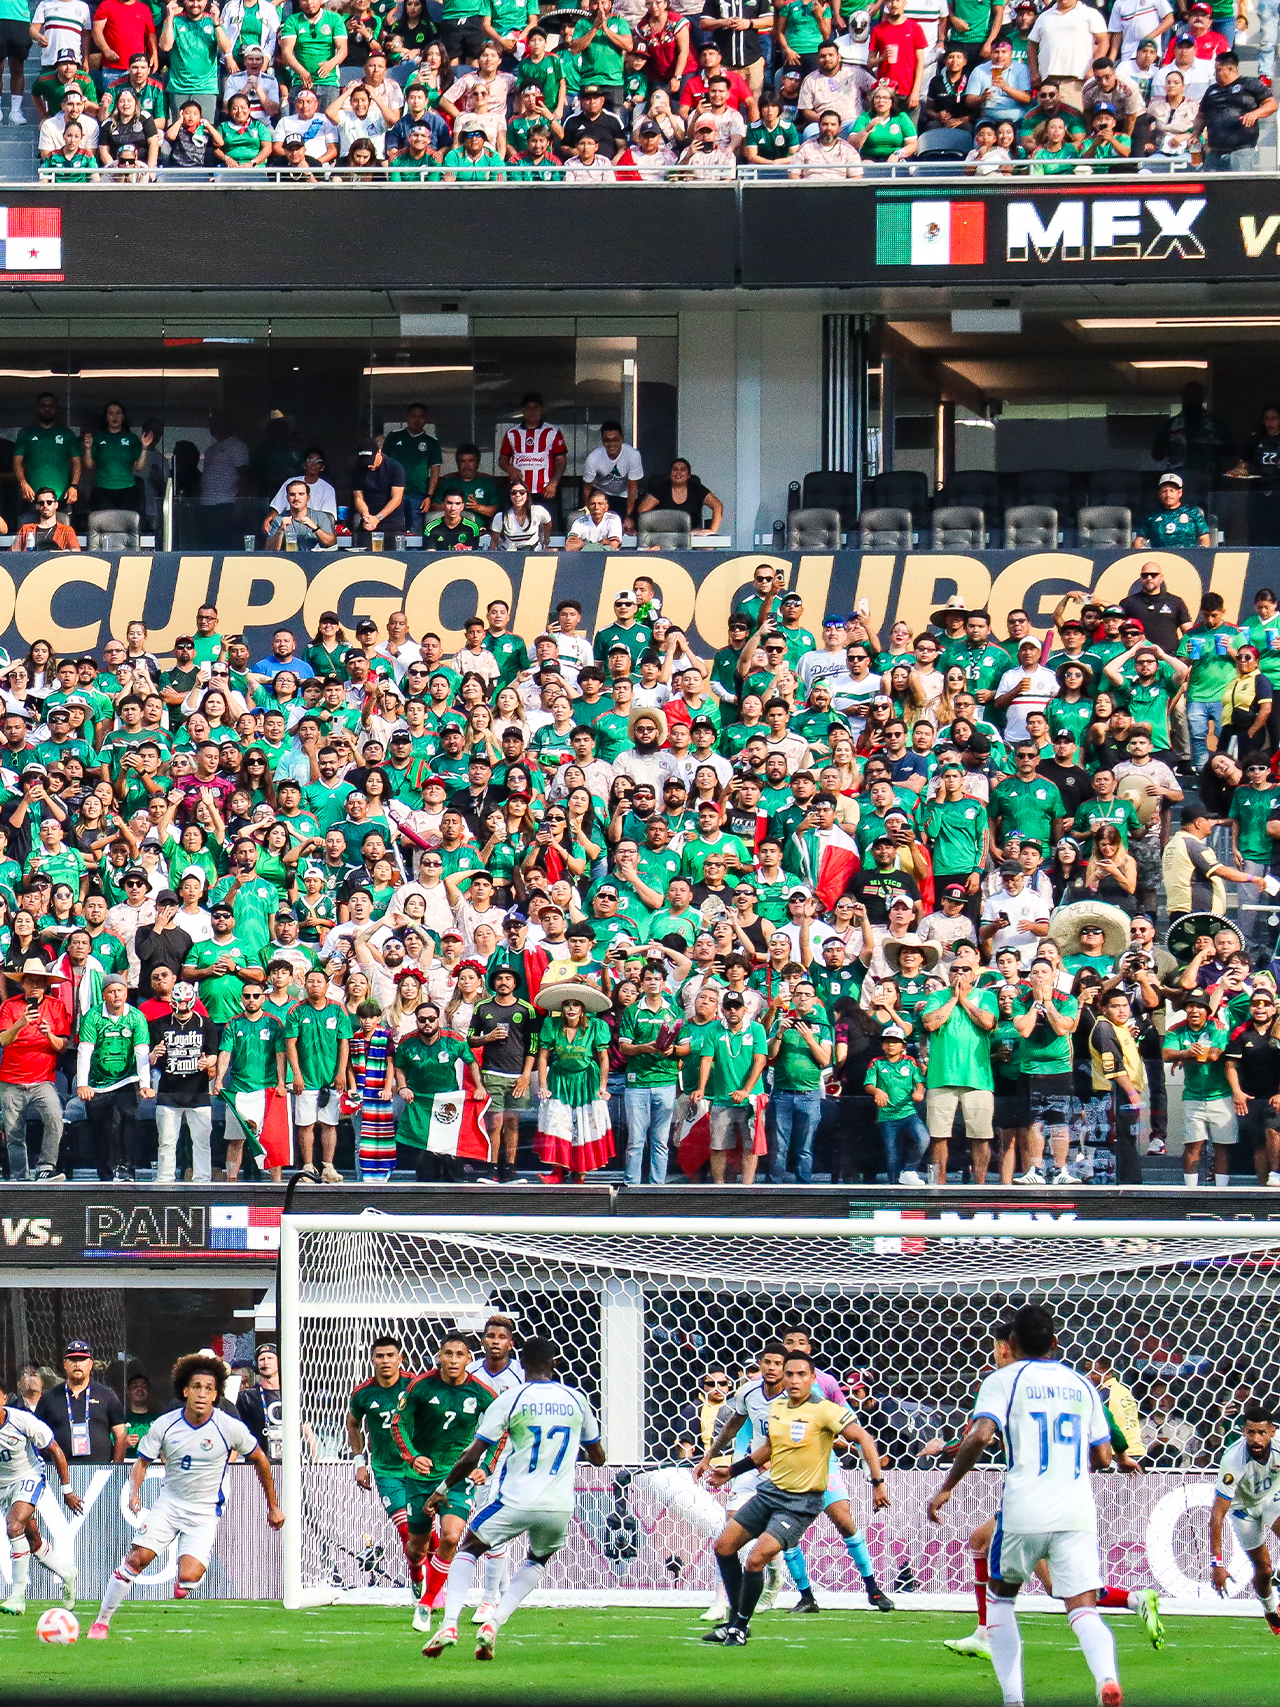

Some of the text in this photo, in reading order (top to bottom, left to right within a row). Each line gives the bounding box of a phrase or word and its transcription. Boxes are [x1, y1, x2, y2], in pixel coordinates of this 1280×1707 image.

[1006, 199, 1206, 262] MEX
[1262, 452, 1277, 465] 22
[1166, 522, 1176, 534] 9
[810, 663, 850, 677] Dodger
[166, 1057, 201, 1075] Famil
[85, 1206, 206, 1247] PAN
[1026, 1385, 1082, 1403] QUINTERO
[379, 1408, 396, 1429] 2
[521, 1402, 574, 1418] FAJARDO
[444, 1410, 457, 1430] 7
[526, 1425, 571, 1476] 17
[1030, 1411, 1082, 1480] 19
[20, 1478, 36, 1493] 10
